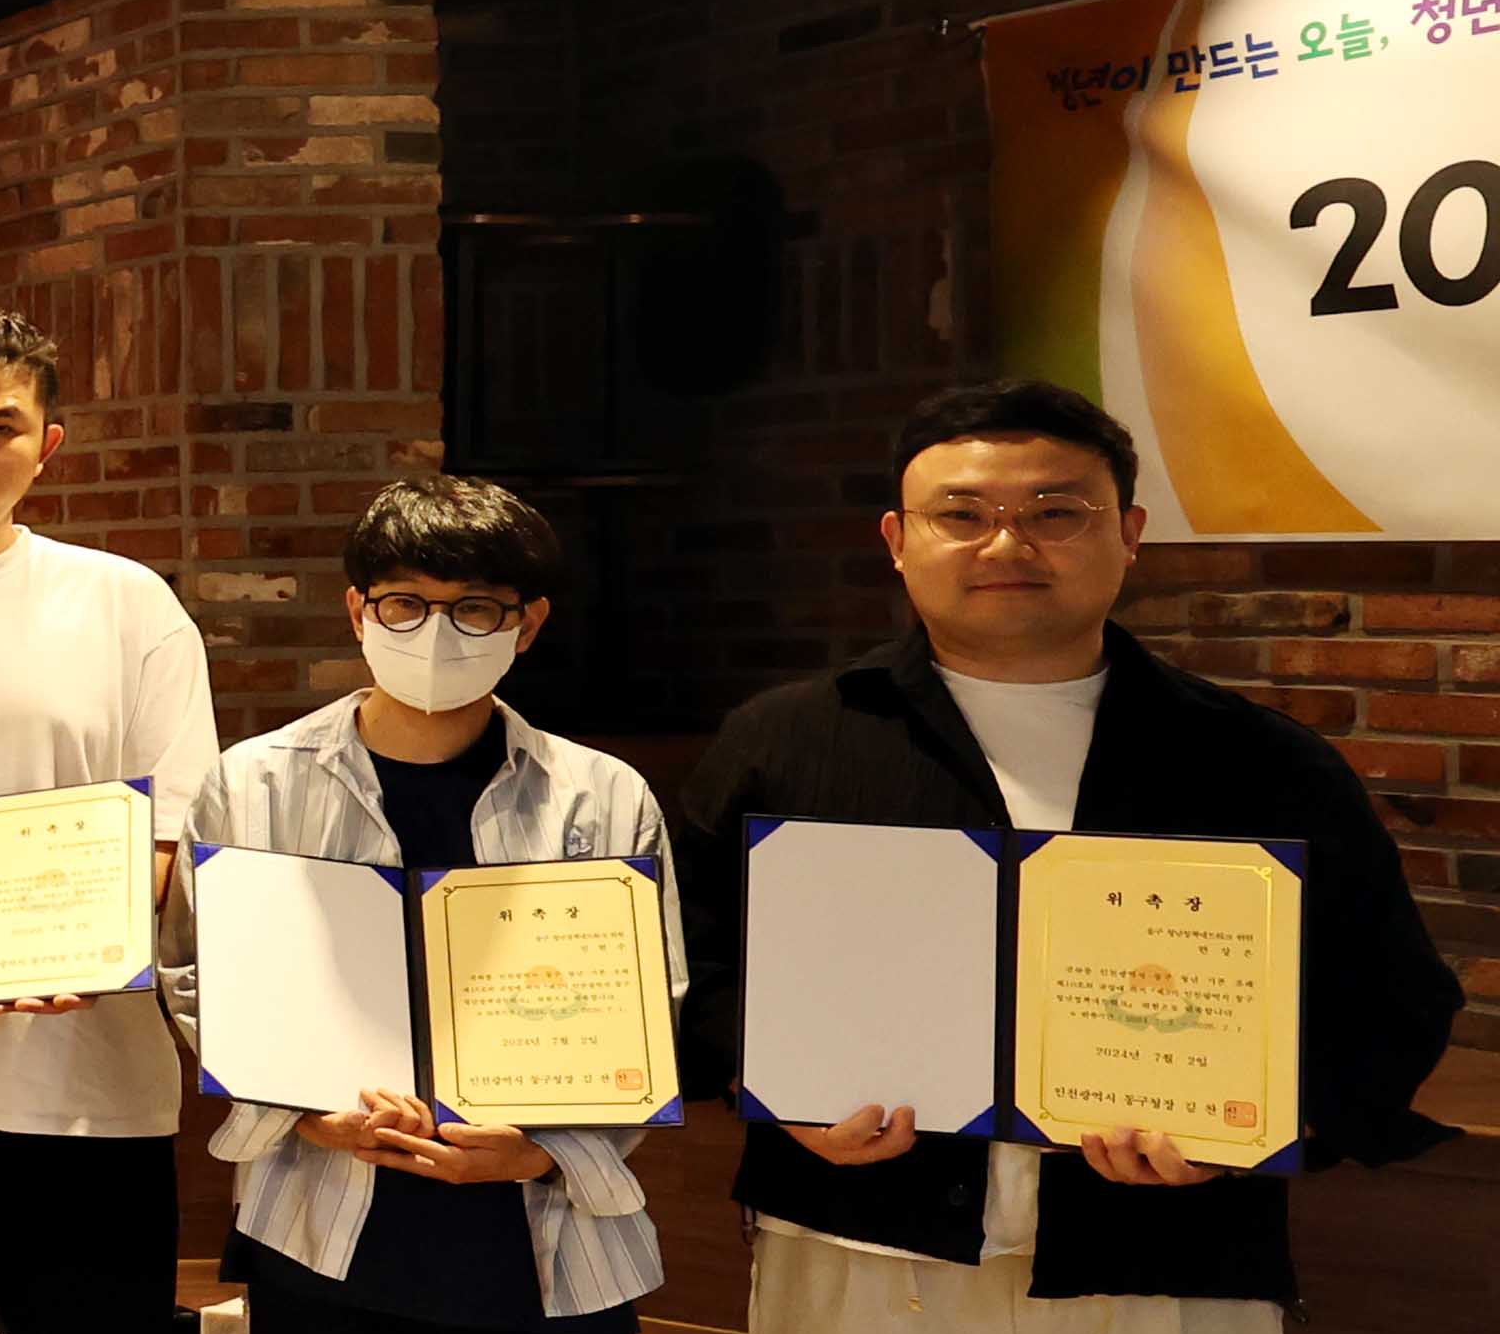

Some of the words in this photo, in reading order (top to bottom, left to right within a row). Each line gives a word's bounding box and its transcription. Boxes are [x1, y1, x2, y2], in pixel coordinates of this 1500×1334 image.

[1167, 33, 1280, 94] 만드는
[1297, 13, 1389, 62] 오늘,
[1290, 160, 1500, 317] 20
